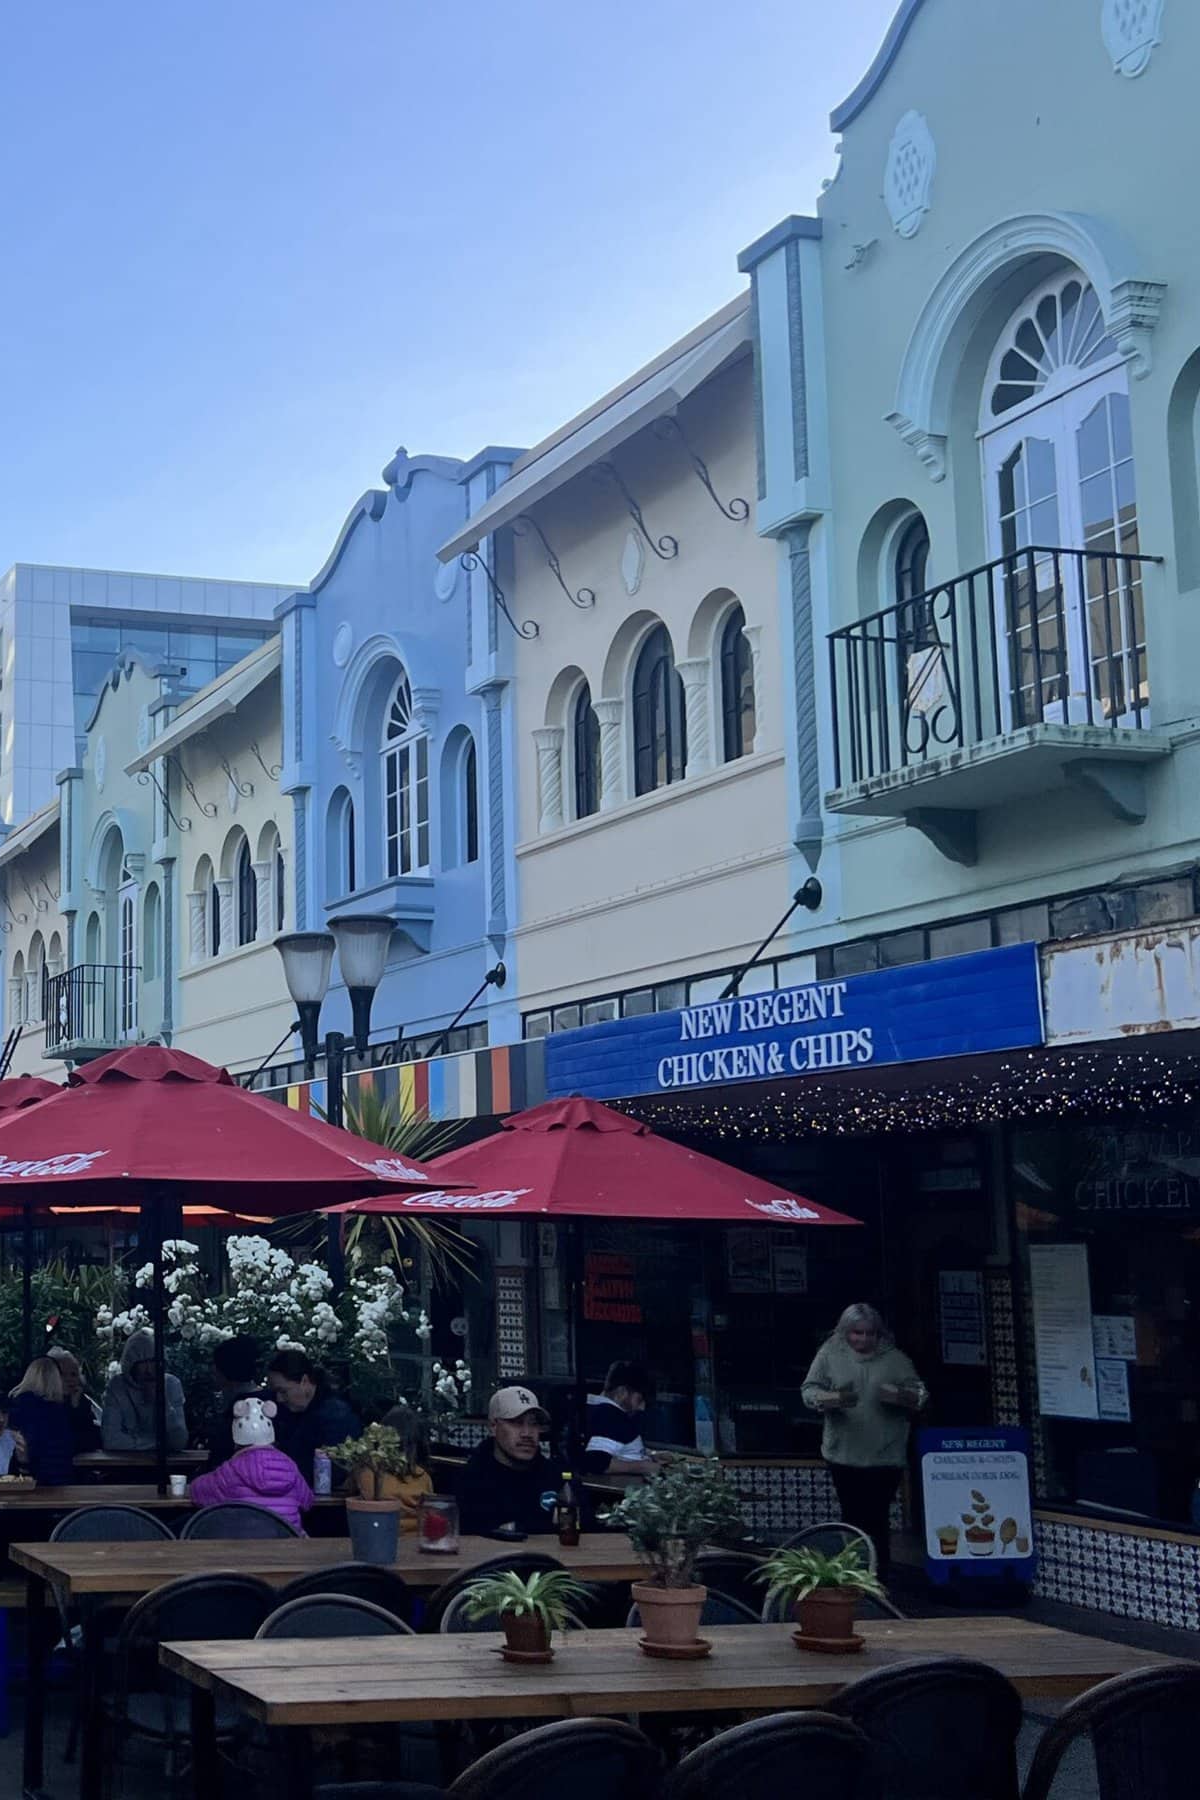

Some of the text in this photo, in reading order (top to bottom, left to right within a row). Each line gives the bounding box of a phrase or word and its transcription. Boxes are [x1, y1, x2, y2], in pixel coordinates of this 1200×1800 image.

[680, 982, 847, 1041] NEW REGENT
[789, 1027, 873, 1071] CHIPS
